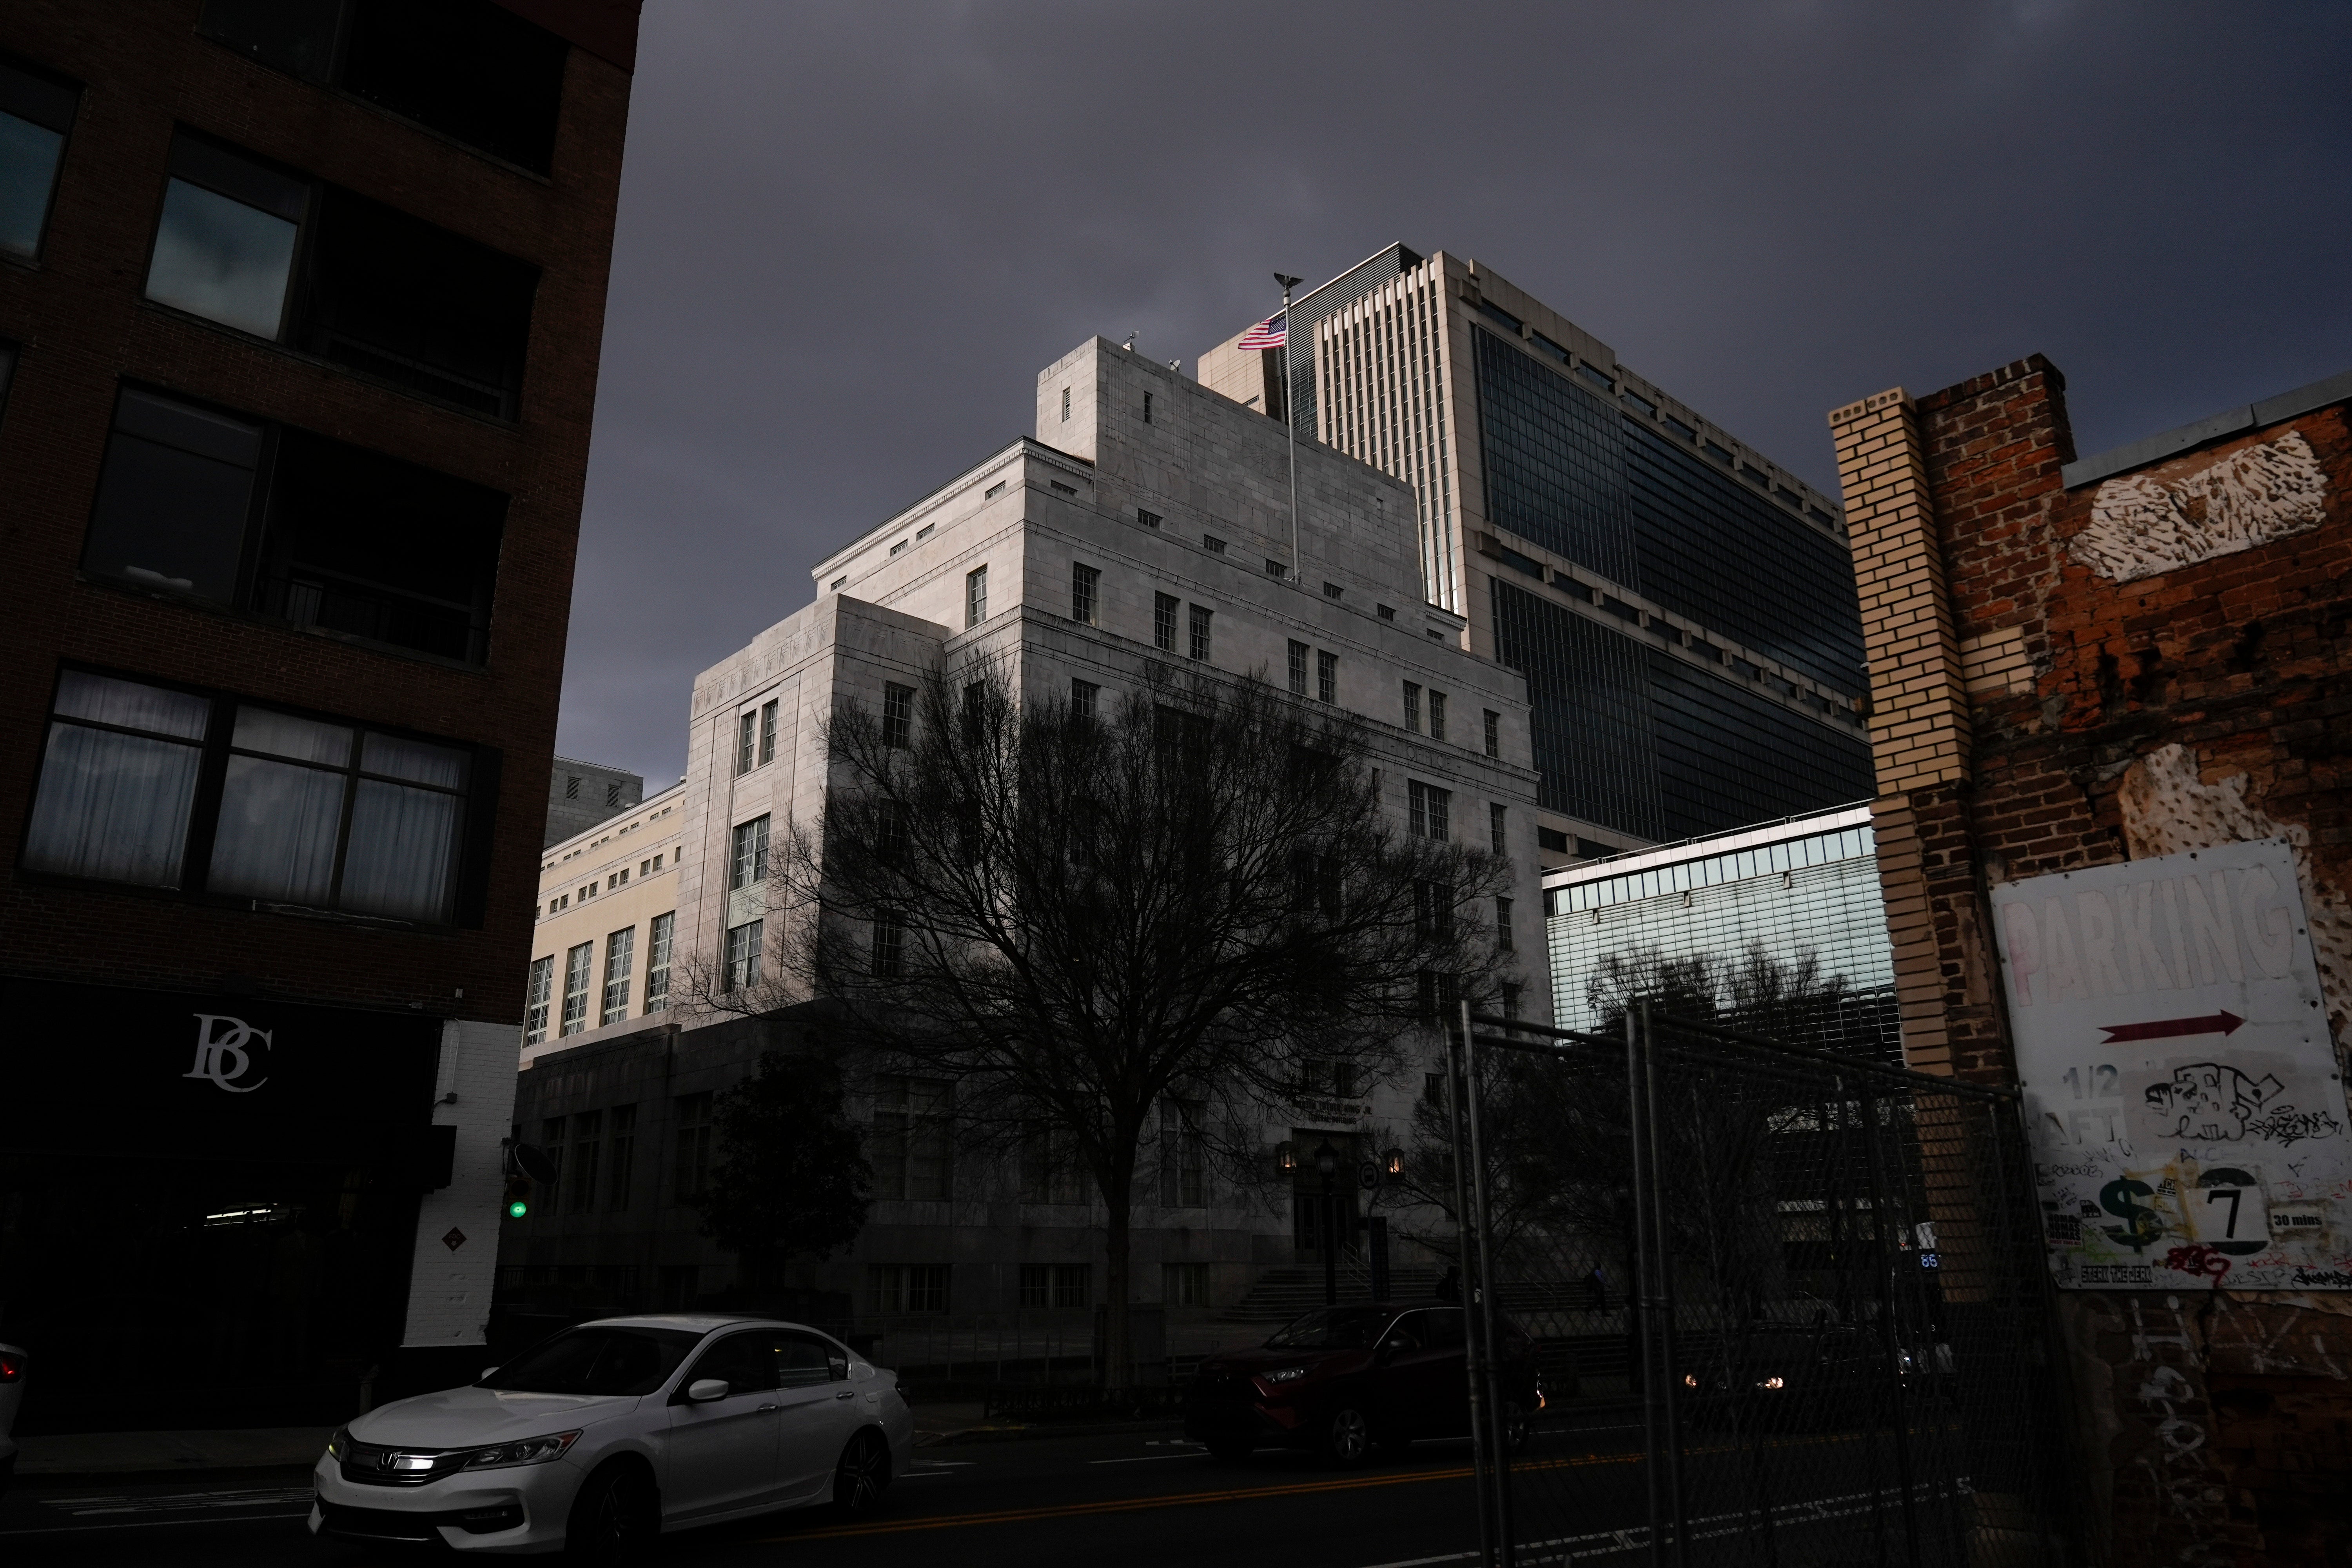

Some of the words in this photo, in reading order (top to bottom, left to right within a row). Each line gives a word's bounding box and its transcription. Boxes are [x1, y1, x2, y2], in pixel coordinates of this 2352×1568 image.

[1406, 746, 1452, 771] OFFICE
[2003, 864, 2293, 1007] PARKING
[2063, 1064, 2121, 1099] 1/2
[1343, 1104, 1360, 1114] KING
[1331, 1116, 1356, 1125] BUILDING
[2048, 1214, 2081, 1223] NOMA
[2100, 1175, 2163, 1253] $
[2207, 1189, 2241, 1239] 7
[2274, 1214, 2290, 1226] 30
[2292, 1214, 2323, 1226] mins
[2049, 1223, 2081, 1232] NOMAS
[2050, 1231, 2081, 1240] NOMAS
[1921, 1254, 1938, 1267] 86
